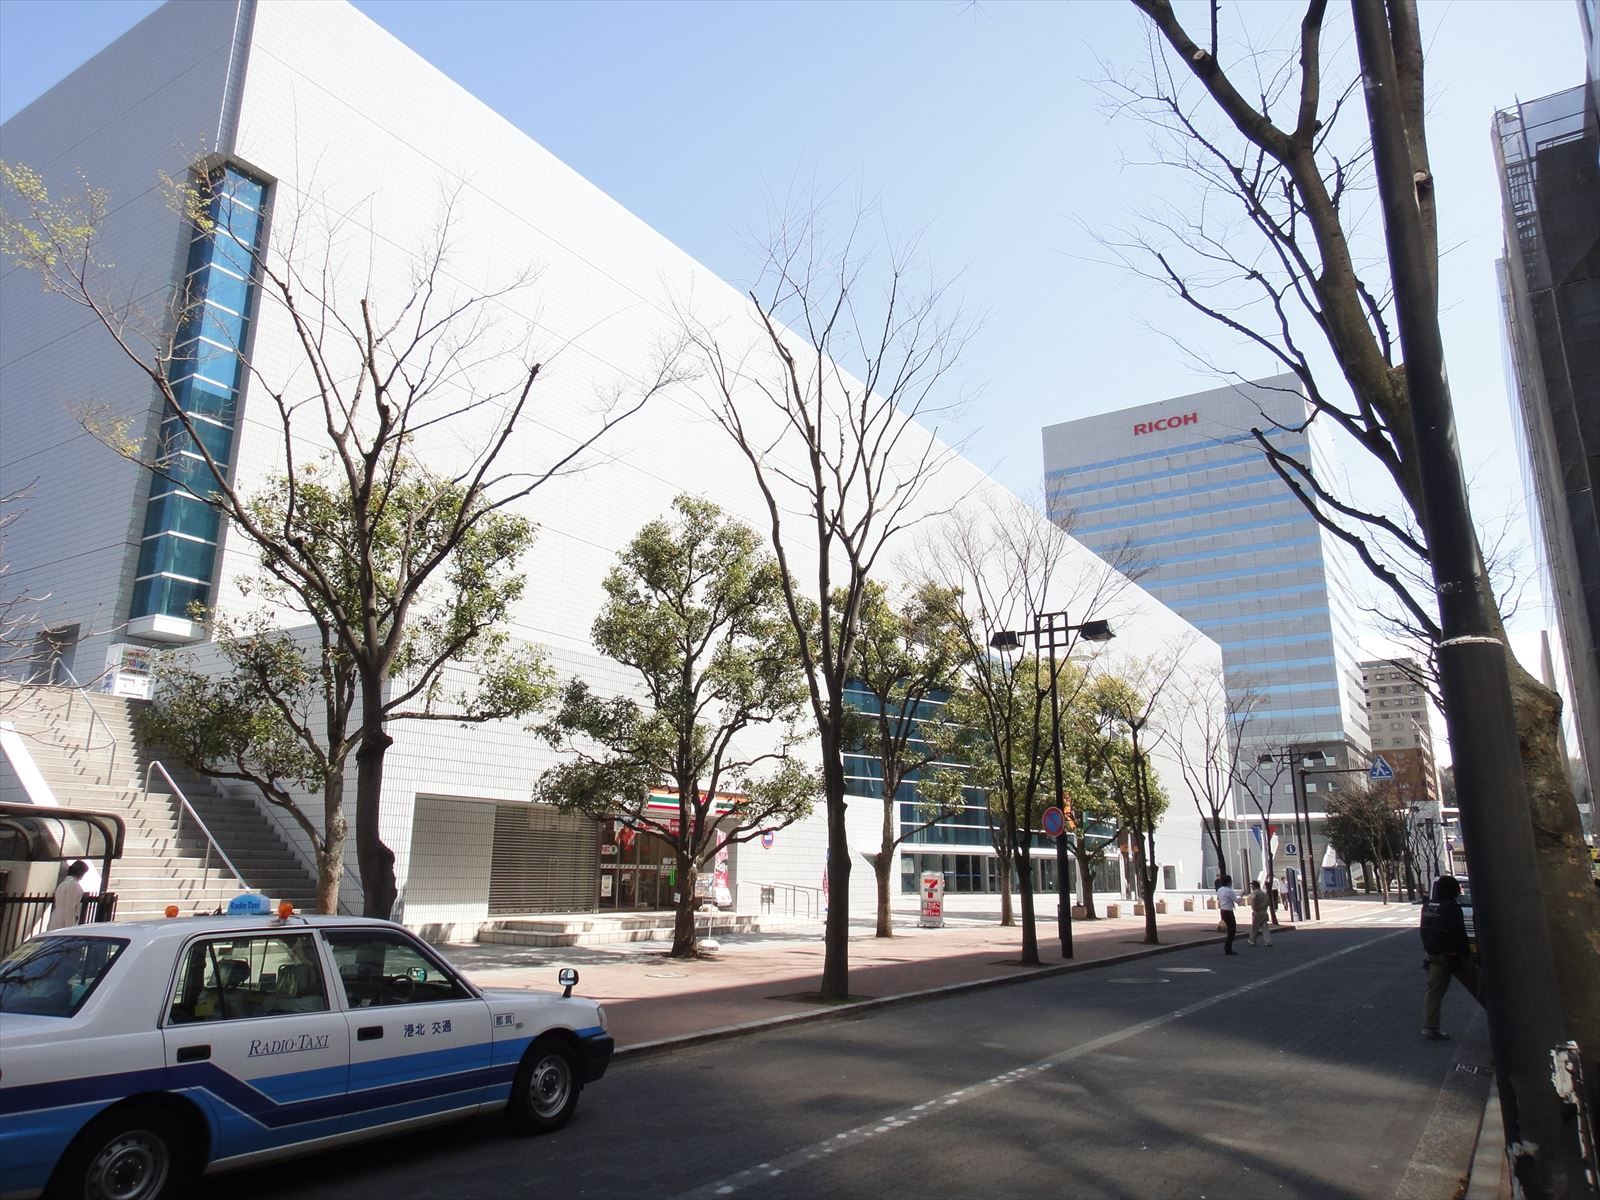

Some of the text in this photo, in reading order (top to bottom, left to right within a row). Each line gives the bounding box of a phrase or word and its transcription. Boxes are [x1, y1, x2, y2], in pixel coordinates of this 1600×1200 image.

[1133, 412, 1198, 436] RICOH
[924, 879, 938, 898] 7
[230, 901, 260, 909] Radio Taxi
[403, 1019, 452, 1037] 港北 交通
